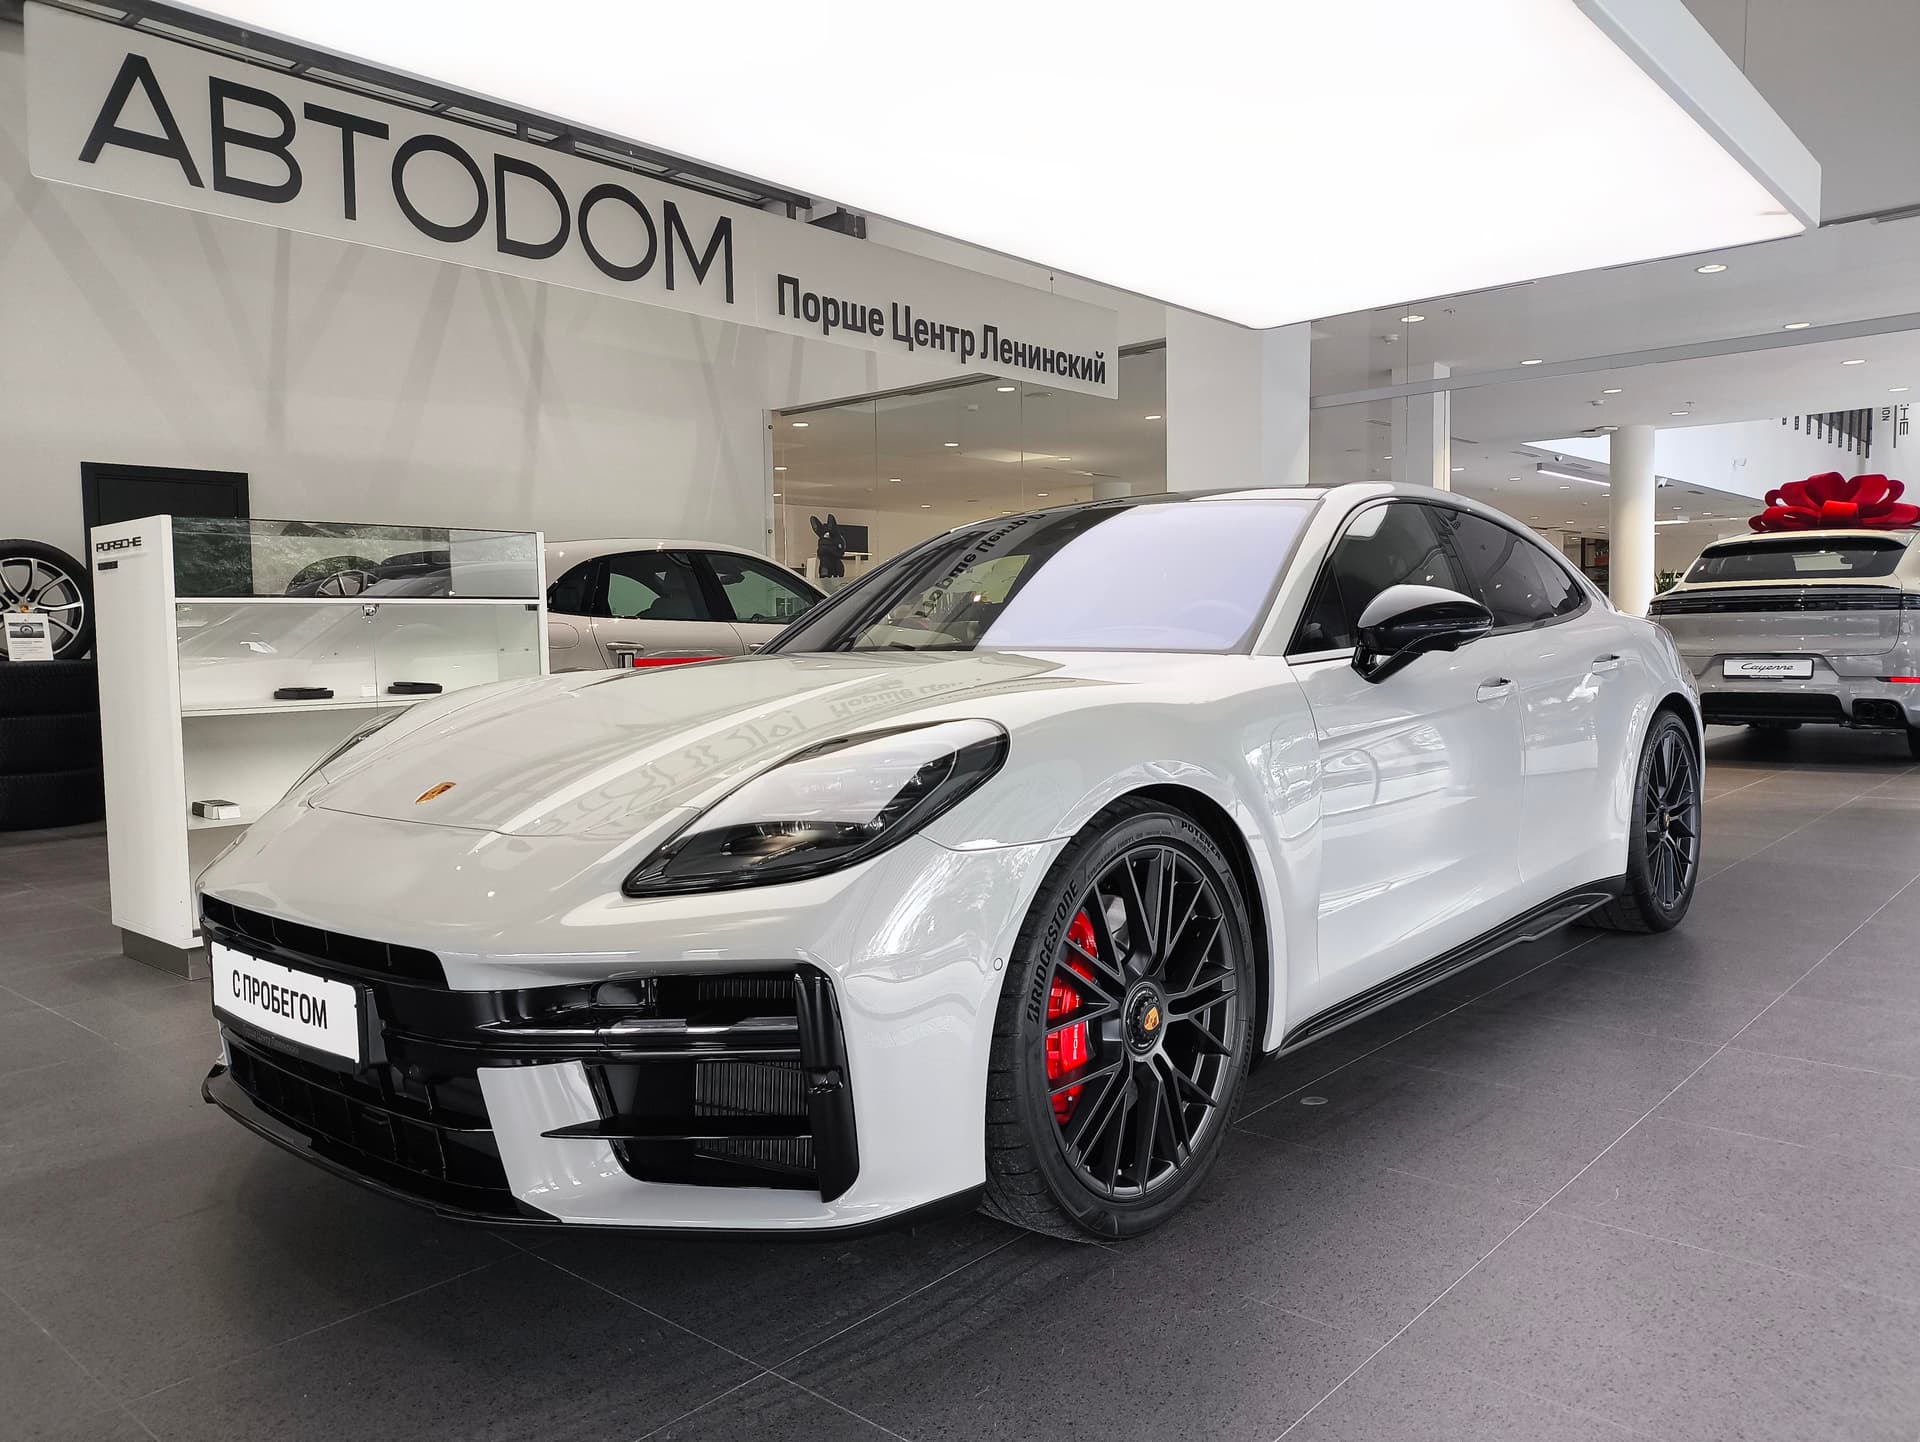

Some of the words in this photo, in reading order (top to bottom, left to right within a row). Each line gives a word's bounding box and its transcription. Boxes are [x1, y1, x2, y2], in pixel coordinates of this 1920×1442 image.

[777, 274, 885, 337] Порше
[892, 302, 976, 364] Центр
[980, 324, 1107, 385] Ленинский
[96, 536, 142, 552] PORSCHE
[1740, 662, 1794, 673] Cayenne
[1181, 820, 1221, 861] POTENZA
[1027, 878, 1079, 1025] BRIDGESTONE
[232, 969, 241, 998] С
[243, 972, 328, 1030] ПРОБЕГОМ
